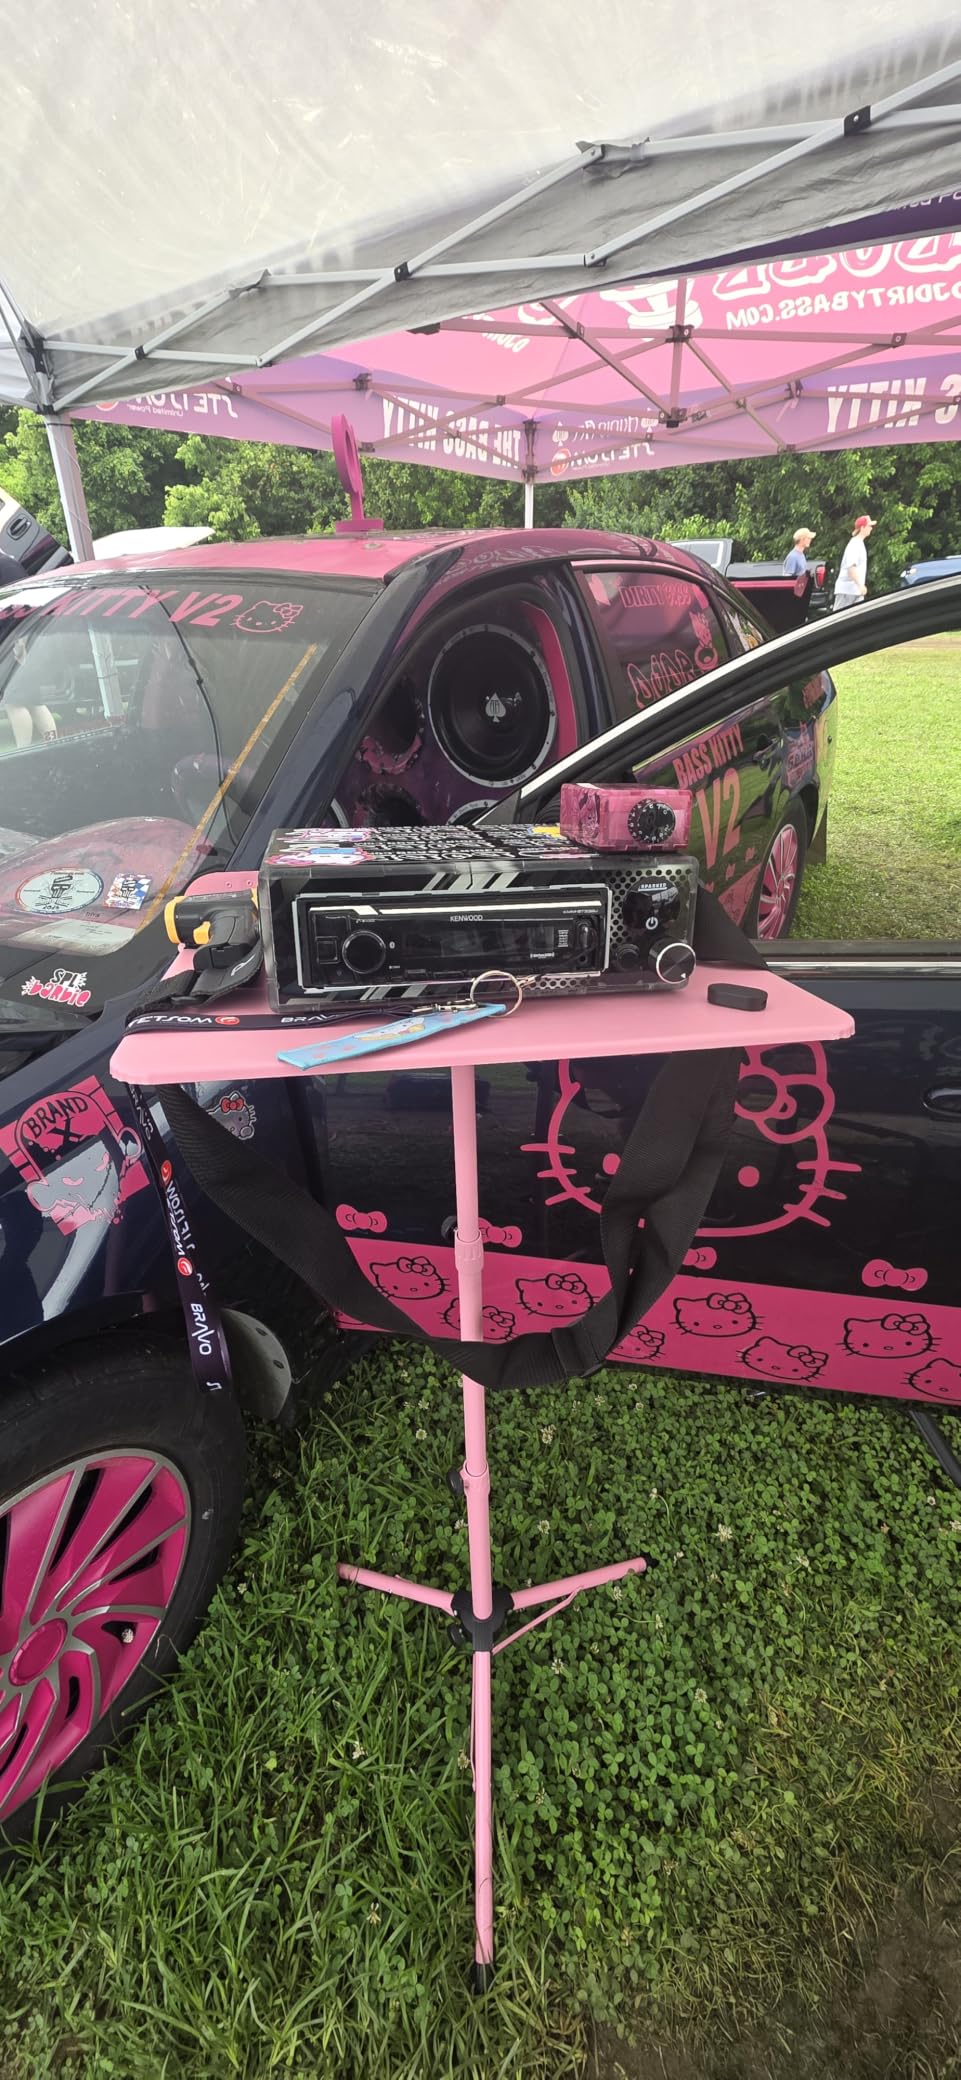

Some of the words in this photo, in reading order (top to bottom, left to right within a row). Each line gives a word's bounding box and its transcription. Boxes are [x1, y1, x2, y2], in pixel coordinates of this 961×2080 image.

[40, 588, 178, 619] KITTY
[169, 591, 243, 627] V2
[672, 744, 713, 790] BASS
[709, 723, 745, 767] KITTY
[695, 767, 741, 870] V2
[450, 914, 483, 923] KENWOOD
[51, 968, 78, 988] SPL
[25, 1096, 89, 1139] BRAND
[47, 1115, 83, 1148] X
[190, 1302, 213, 1356] BRAVO
